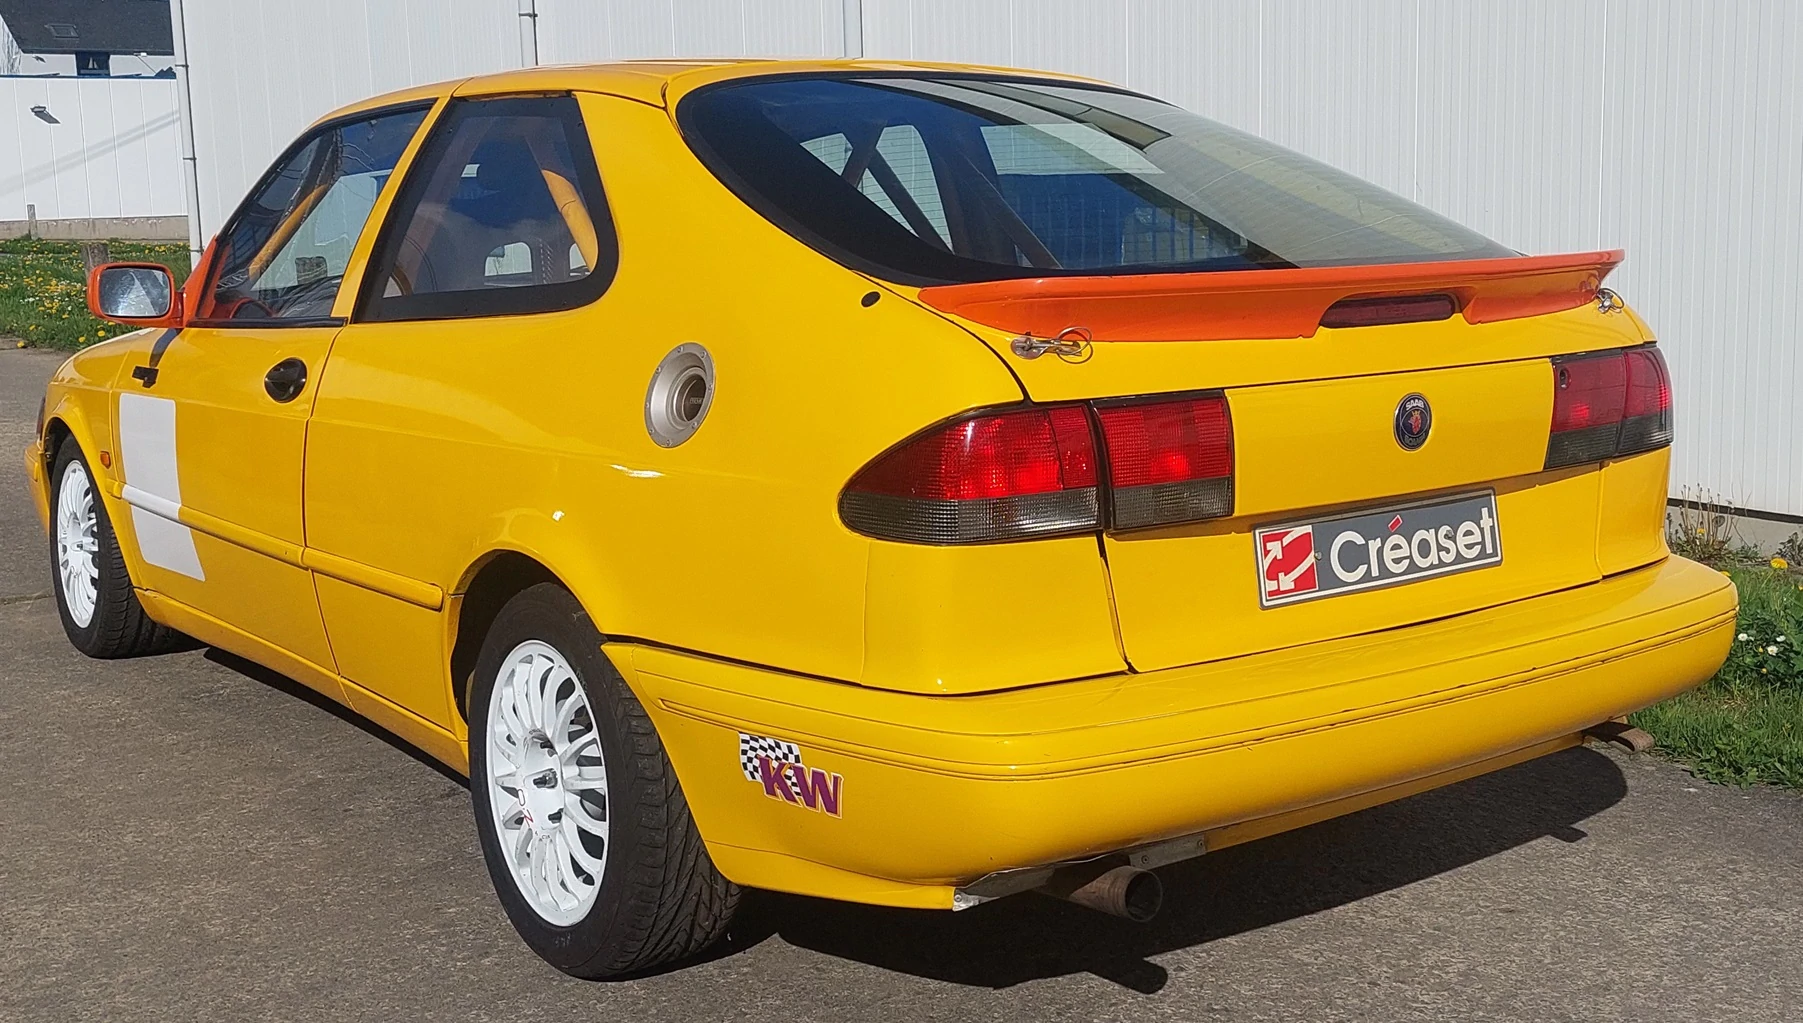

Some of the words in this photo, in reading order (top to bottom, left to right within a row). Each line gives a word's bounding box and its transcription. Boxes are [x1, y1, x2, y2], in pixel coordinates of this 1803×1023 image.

[1406, 399, 1424, 410] SAAB
[1330, 507, 1493, 583] Créaset
[759, 756, 842, 817] KW
